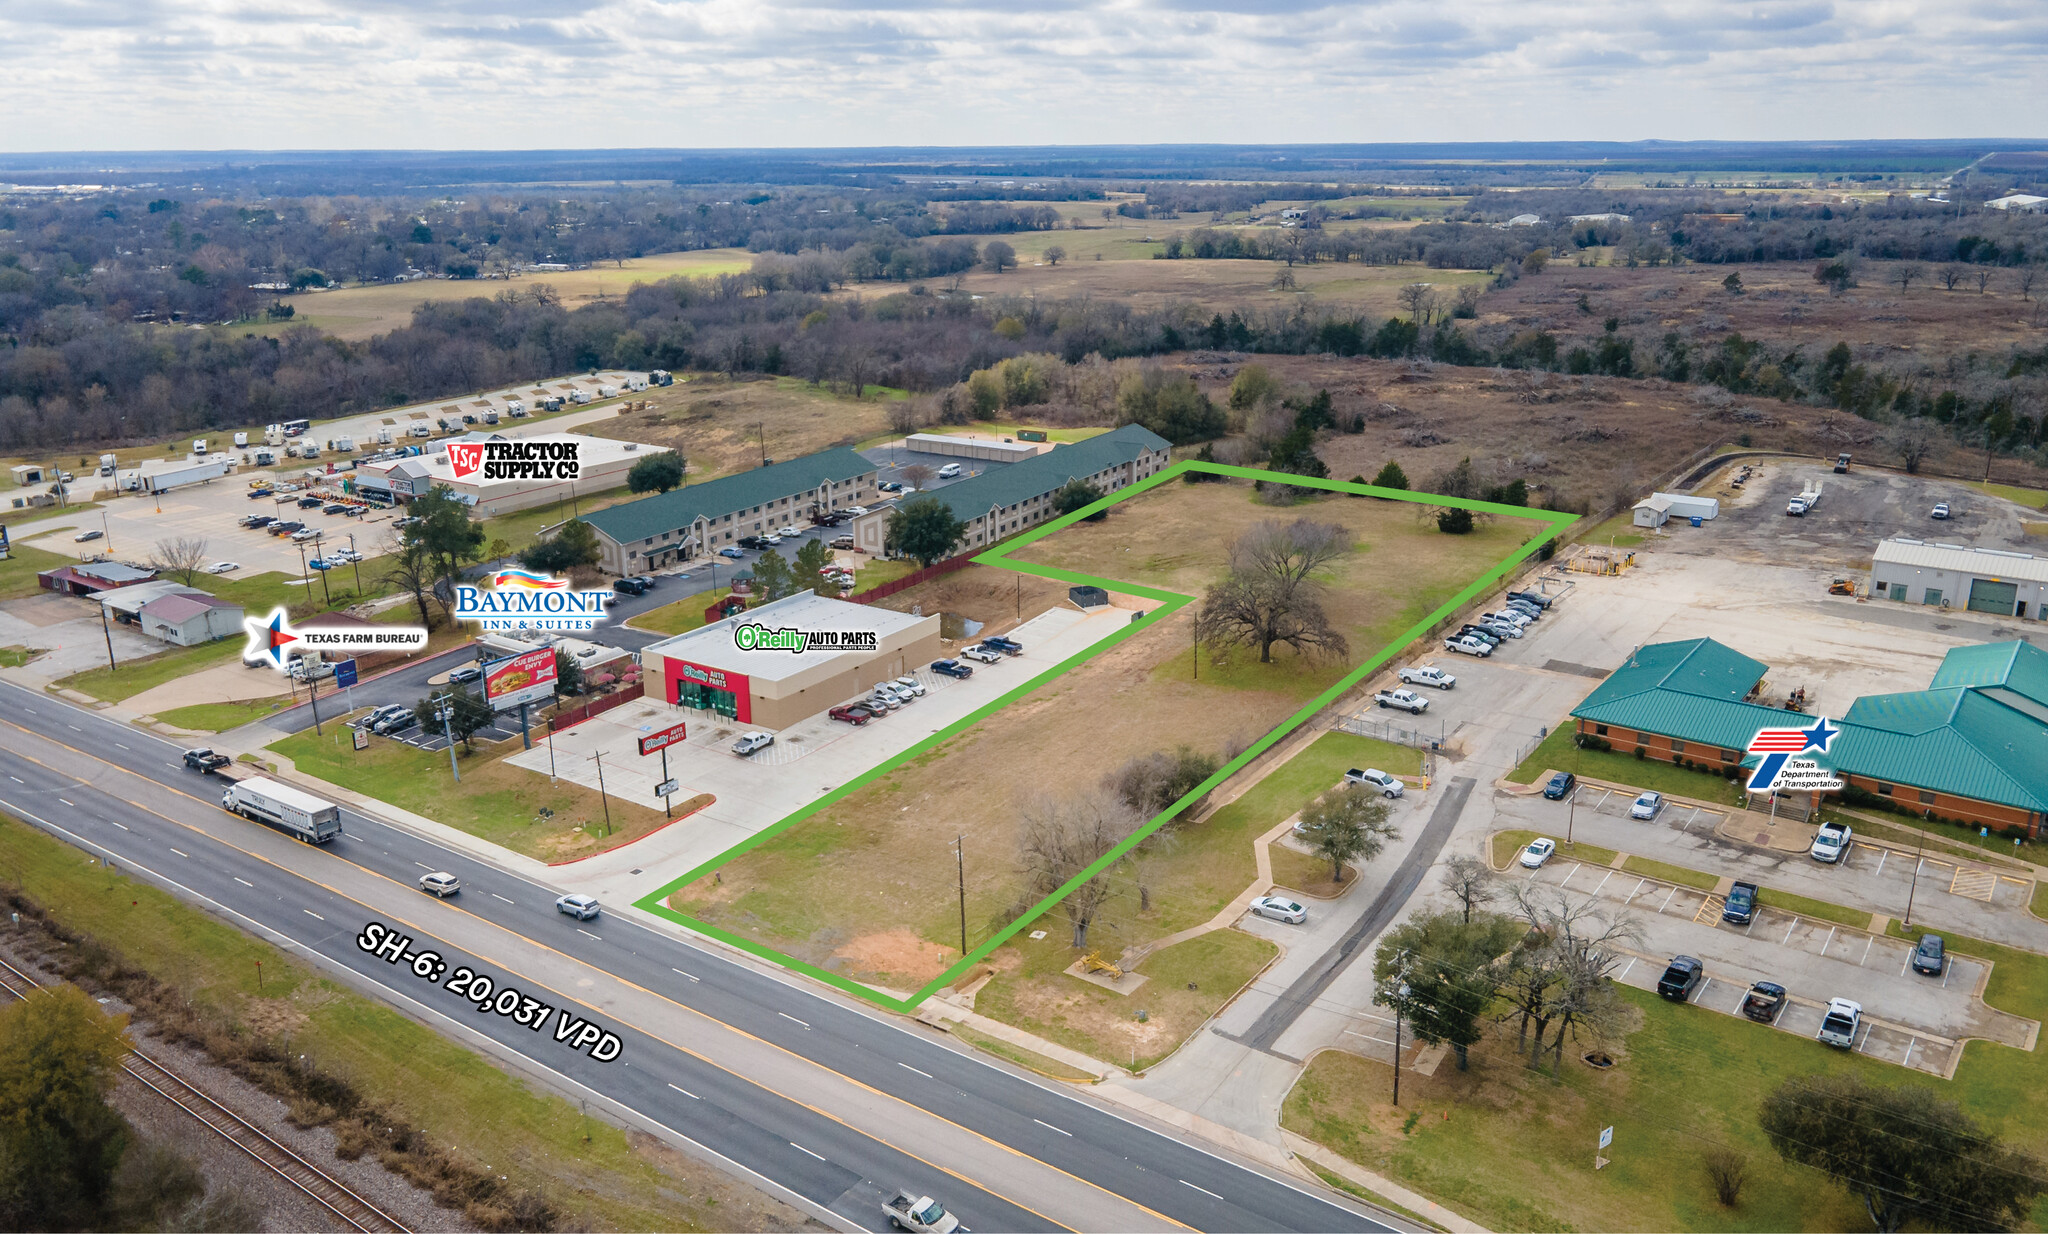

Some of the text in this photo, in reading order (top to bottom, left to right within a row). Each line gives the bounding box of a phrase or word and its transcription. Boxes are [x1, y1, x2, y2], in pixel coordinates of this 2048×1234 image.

[514, 651, 552, 667] CUE BURGER
[524, 660, 542, 670] ENVY
[710, 670, 725, 679] AUTO
[708, 678, 727, 687] PARTS
[670, 727, 683, 736] AUTO
[670, 733, 684, 742] PARTS
